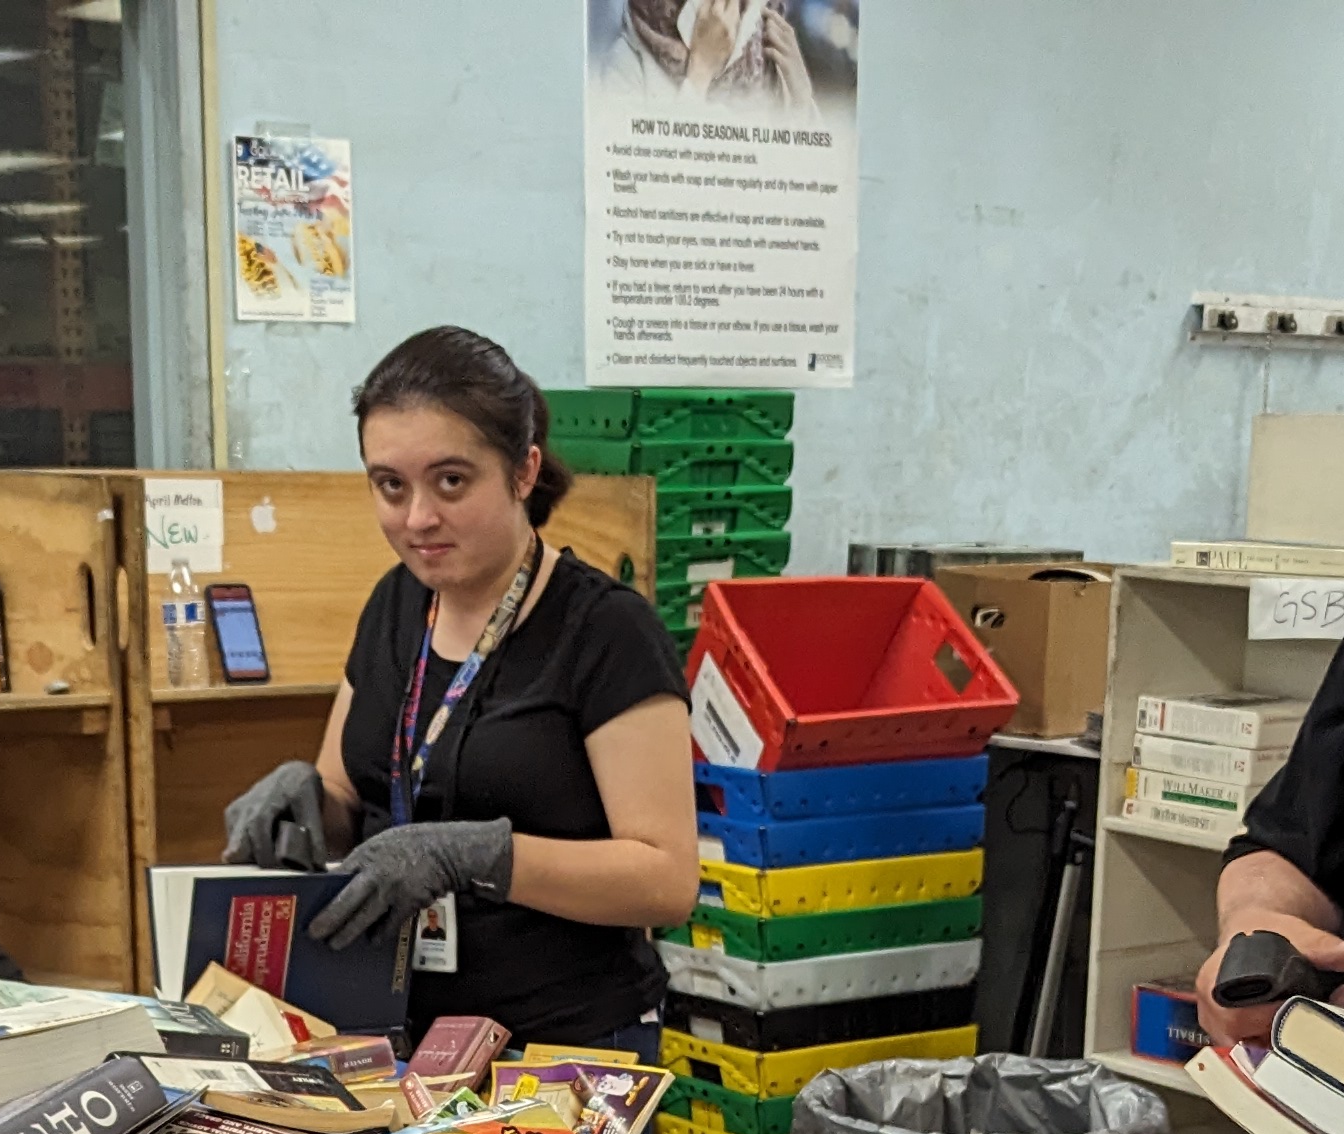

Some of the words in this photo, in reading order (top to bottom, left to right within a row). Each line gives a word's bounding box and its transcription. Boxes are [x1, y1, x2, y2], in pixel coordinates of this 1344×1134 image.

[632, 119, 655, 135] HOW
[657, 121, 669, 136] TO
[673, 122, 700, 138] AVOID
[703, 125, 749, 143] SEASONAL
[752, 127, 770, 144] FLU
[772, 130, 790, 145] AND
[793, 131, 832, 147] VIRUSES:
[237, 165, 310, 192] RETAIL
[612, 256, 628, 269] Stay
[630, 258, 648, 268] home
[670, 260, 681, 271] you
[146, 515, 199, 549] NEW
